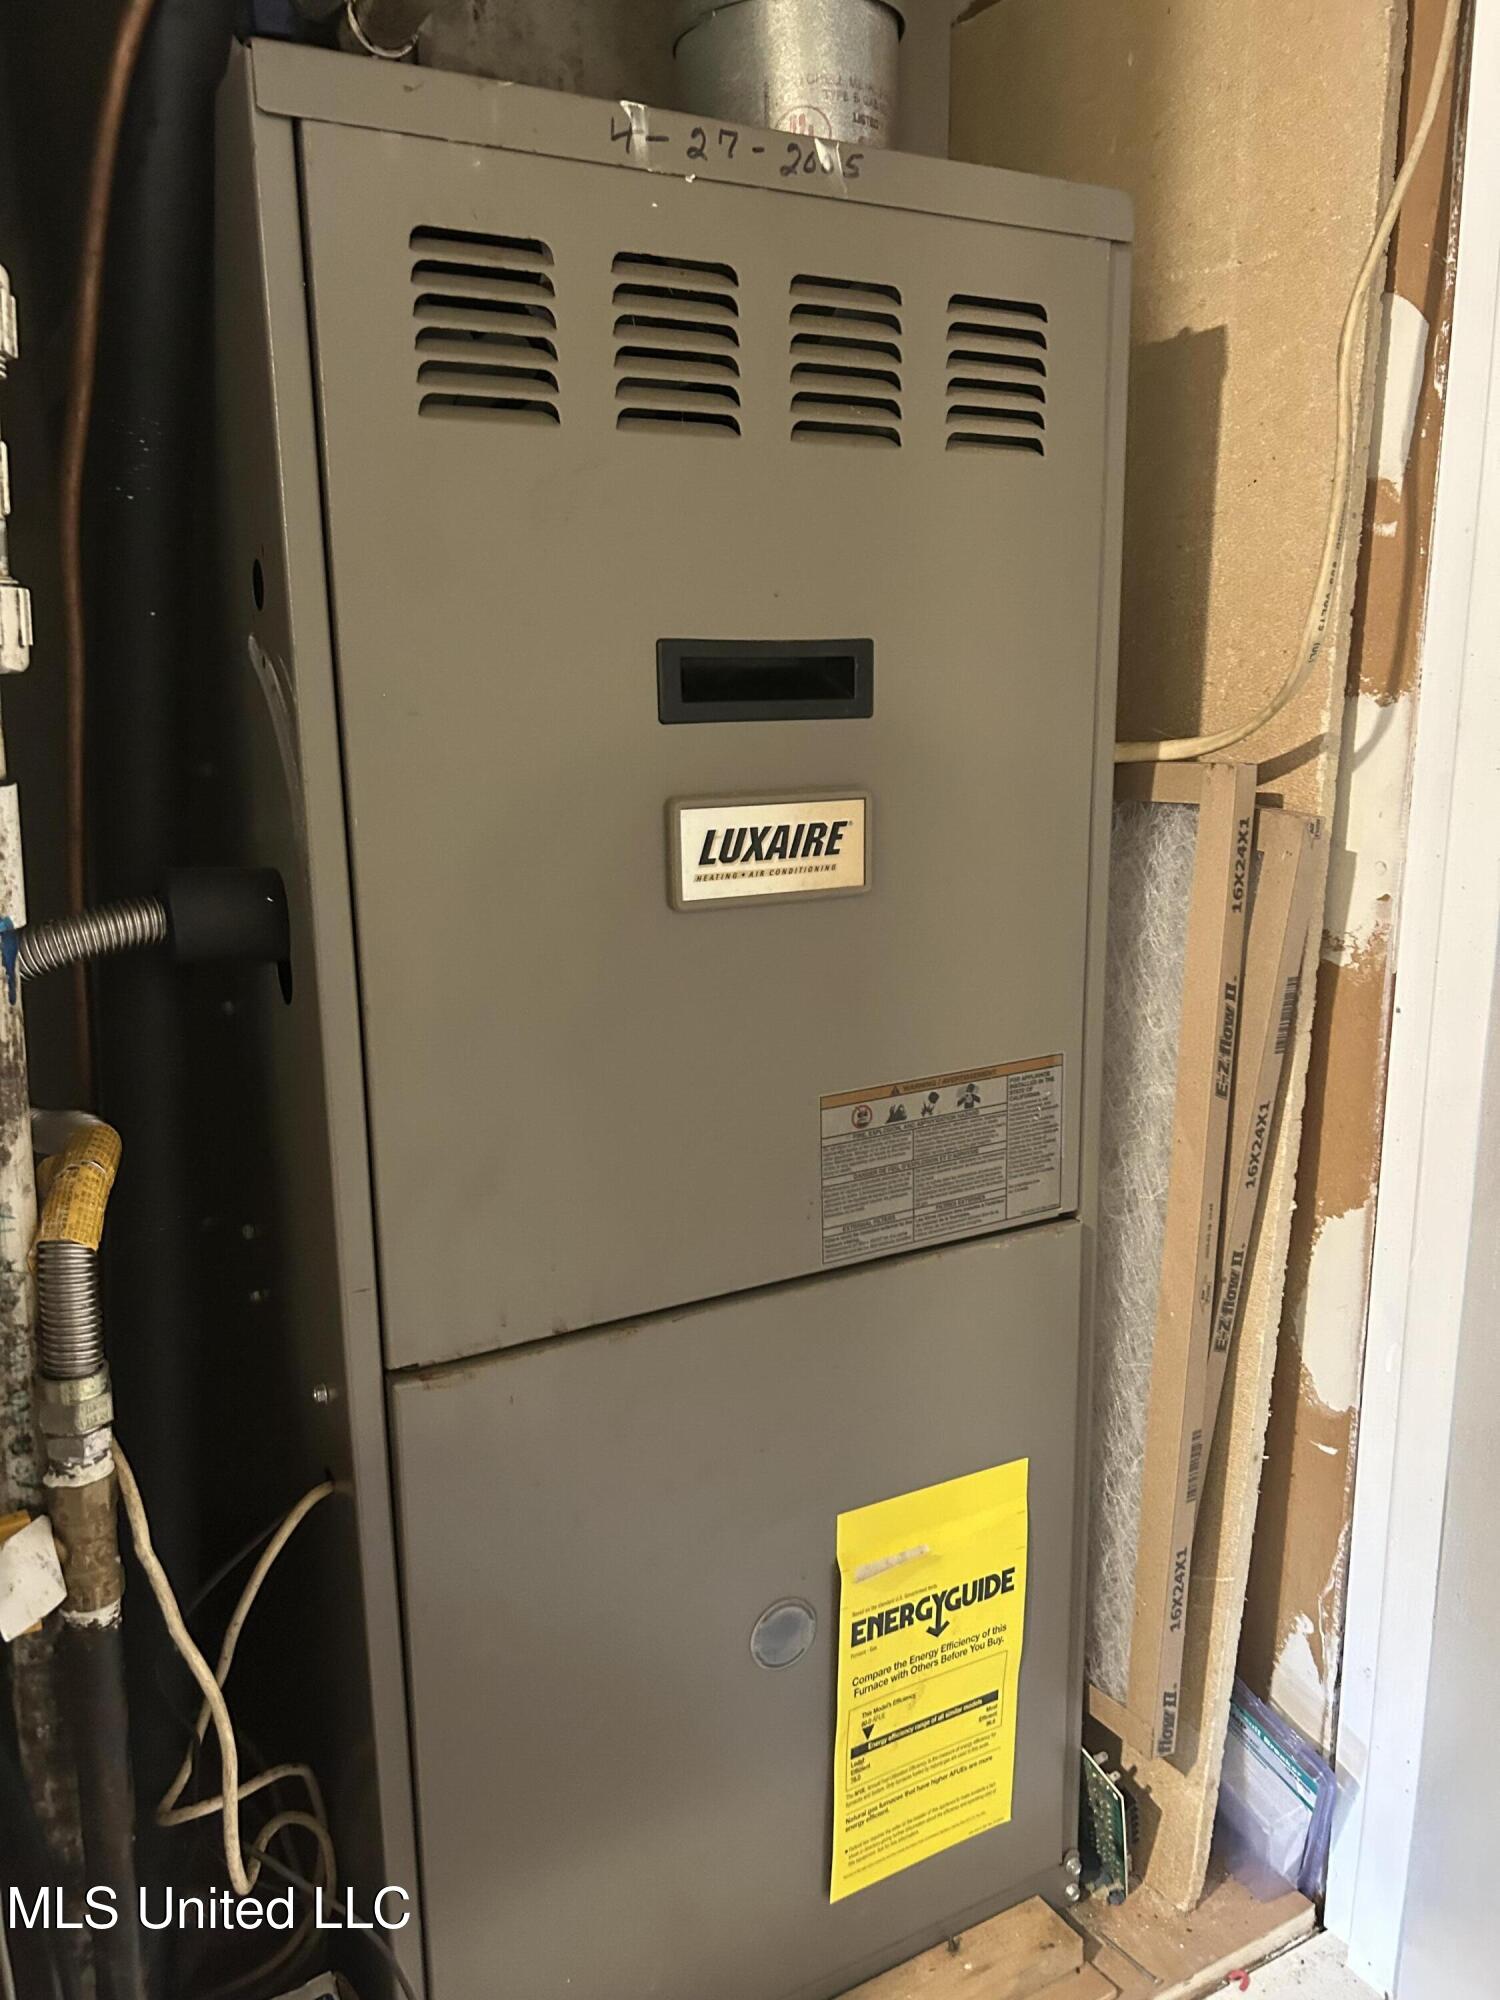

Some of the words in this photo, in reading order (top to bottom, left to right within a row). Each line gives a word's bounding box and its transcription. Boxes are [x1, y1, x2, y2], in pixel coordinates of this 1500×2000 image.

[1318, 593, 1331, 631] VOLTS
[695, 872, 738, 882] HEATING
[748, 869, 764, 879] AIR
[769, 864, 837, 877] CONDITIONING
[698, 820, 848, 866] LUXAIRE
[1231, 816, 1250, 914] 16X24X1
[1219, 1008, 1236, 1059] flow
[1245, 1103, 1270, 1189] 16X24X1
[851, 1567, 1015, 1648] ENERGYGUIDE
[1170, 1547, 1188, 1632] 16X24X1
[852, 1666, 891, 1687] Compare
[893, 1659, 907, 1671] the
[910, 1646, 938, 1665] Energy
[941, 1633, 980, 1653] Efficiency
[982, 1627, 991, 1639] of
[993, 1623, 1007, 1635] this
[854, 1679, 889, 1698] Furnace
[891, 1669, 908, 1682] with
[911, 1659, 938, 1675] Others
[941, 1648, 968, 1664] Before
[970, 1642, 985, 1654] You
[988, 1636, 1004, 1649] Buy.
[868, 1738, 888, 1750] Energy
